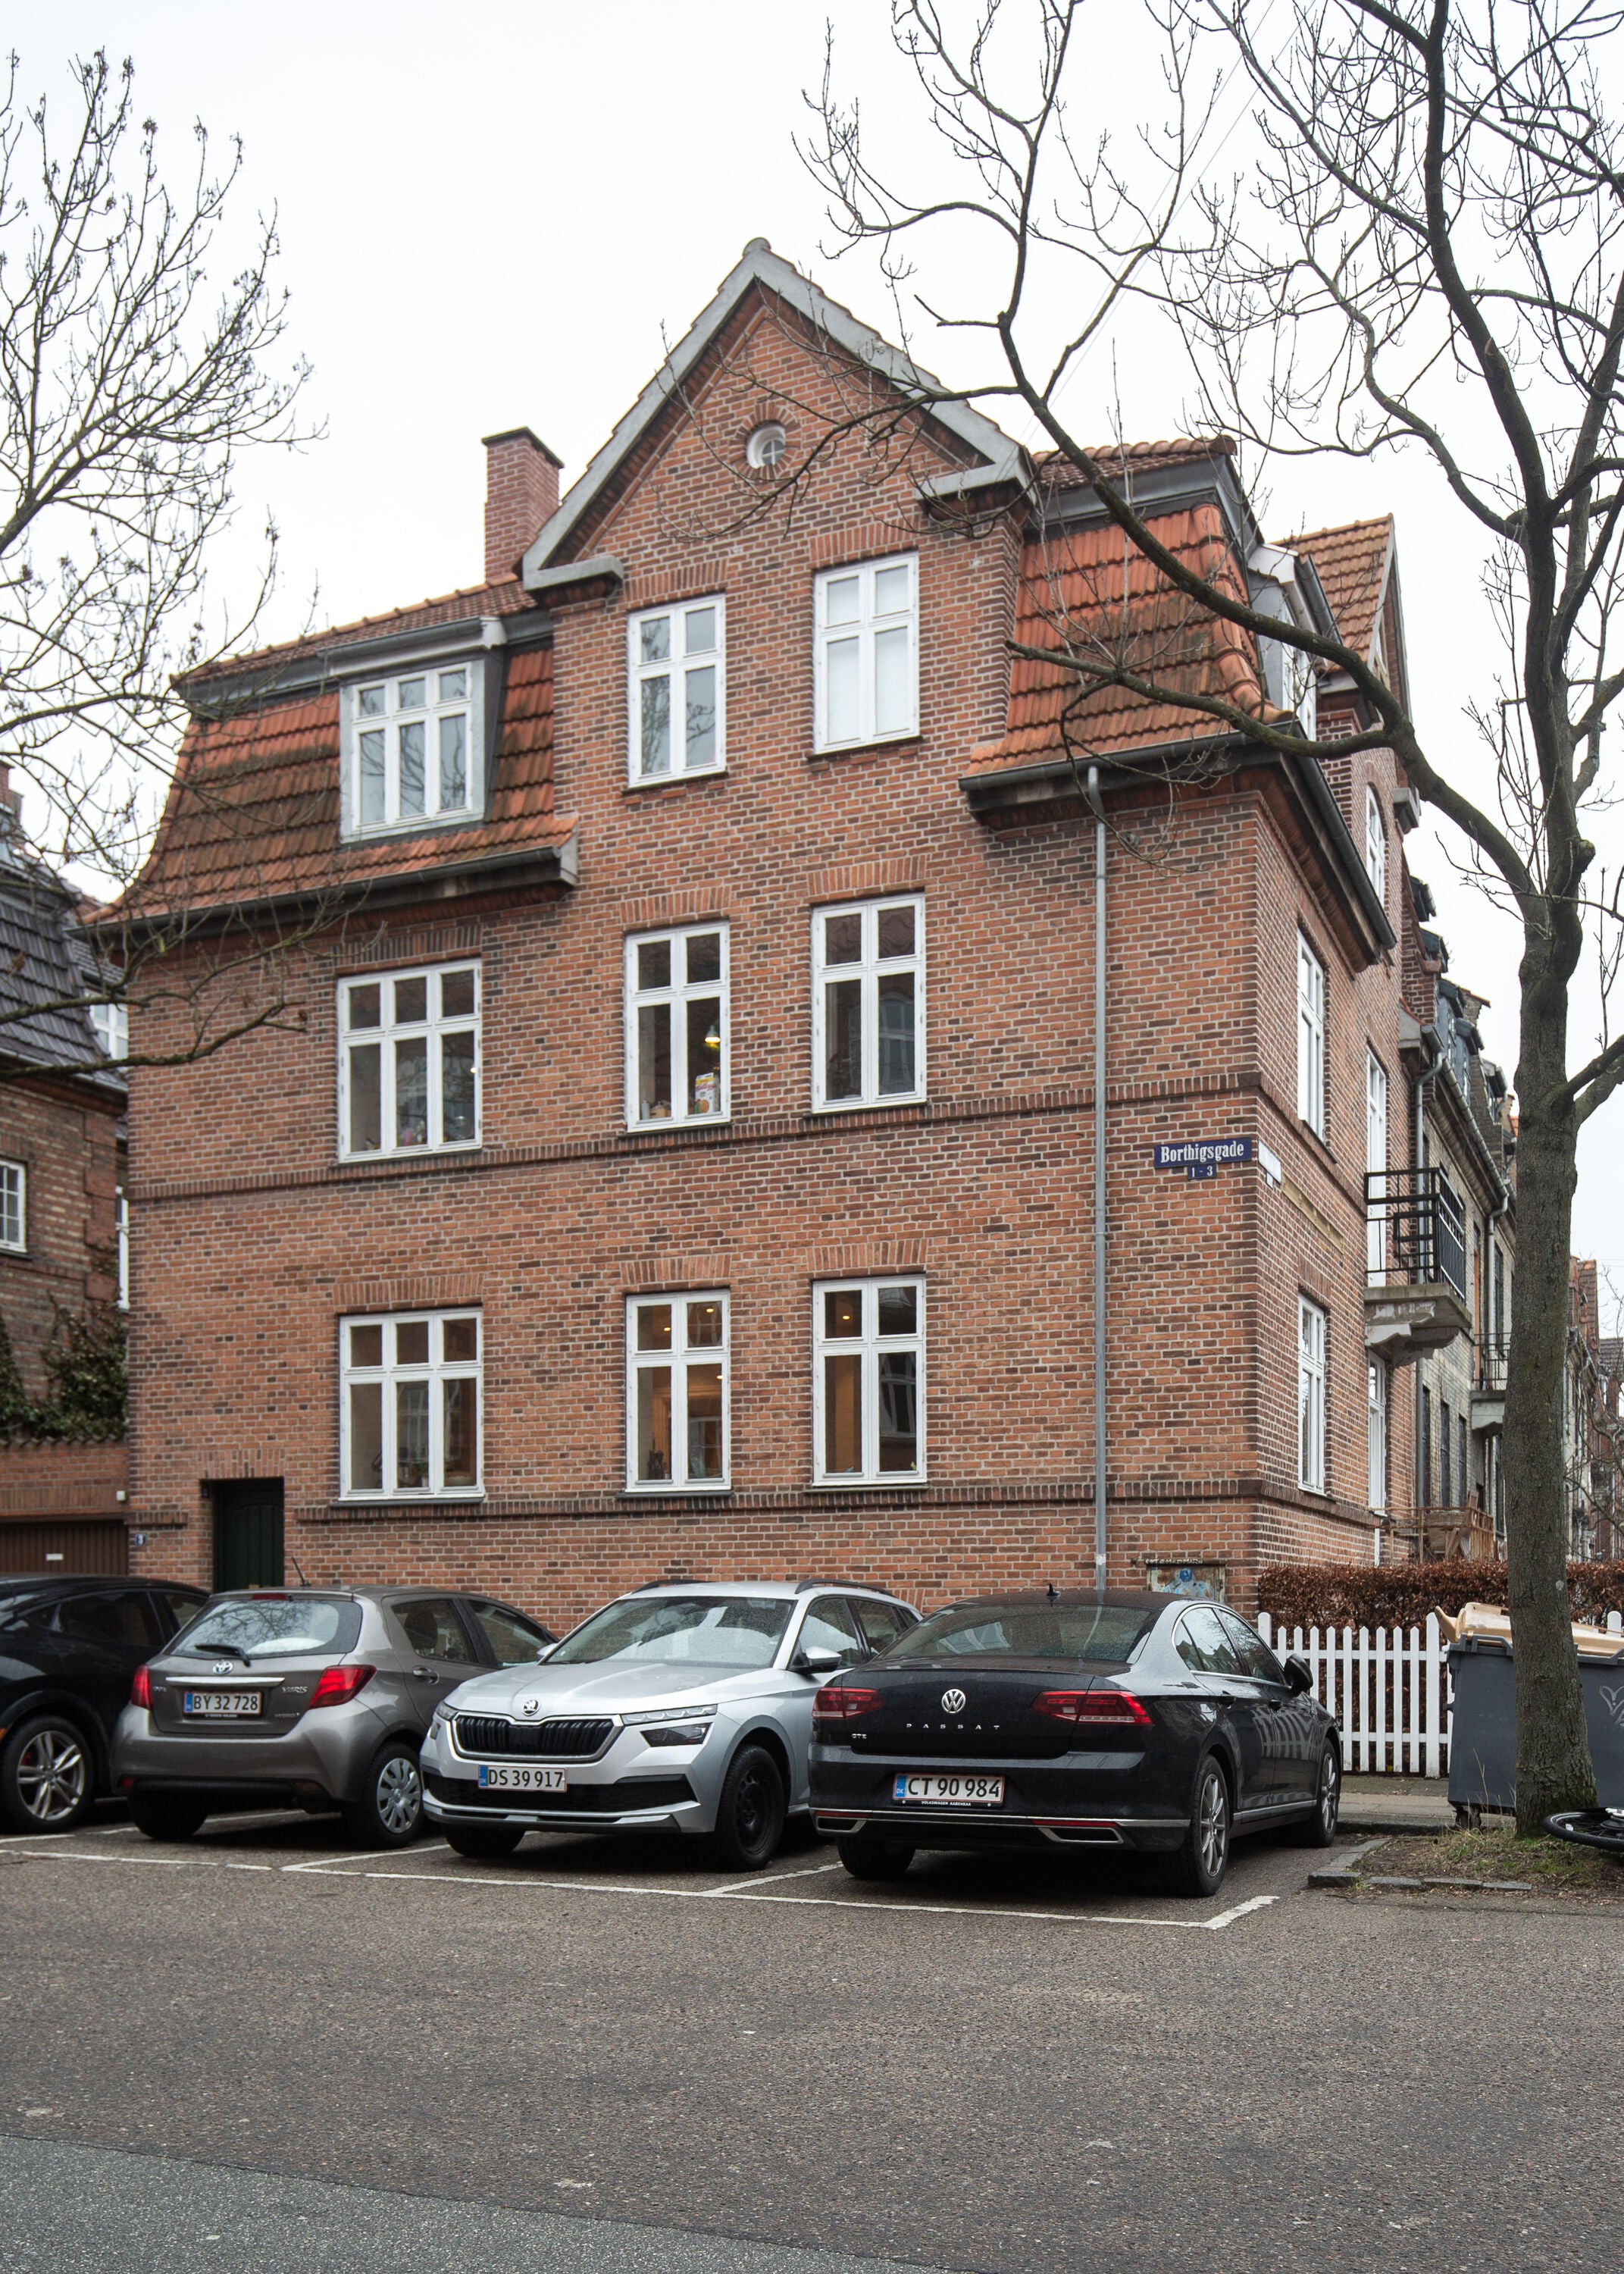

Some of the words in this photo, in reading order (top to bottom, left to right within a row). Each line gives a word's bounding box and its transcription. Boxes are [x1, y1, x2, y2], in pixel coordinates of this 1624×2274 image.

[1160, 1140, 1244, 1163] Borthigsgade
[1191, 1167, 1195, 1178] 1
[1206, 1166, 1213, 1176] 3
[193, 1695, 211, 1710] BY
[214, 1695, 230, 1710] 32
[233, 1695, 258, 1711] 728
[488, 1768, 508, 1786] DS
[512, 1769, 530, 1787] 39
[534, 1770, 563, 1788] 917
[908, 1777, 934, 1796] CT
[937, 1778, 959, 1796] 90
[965, 1778, 1000, 1798] 984
